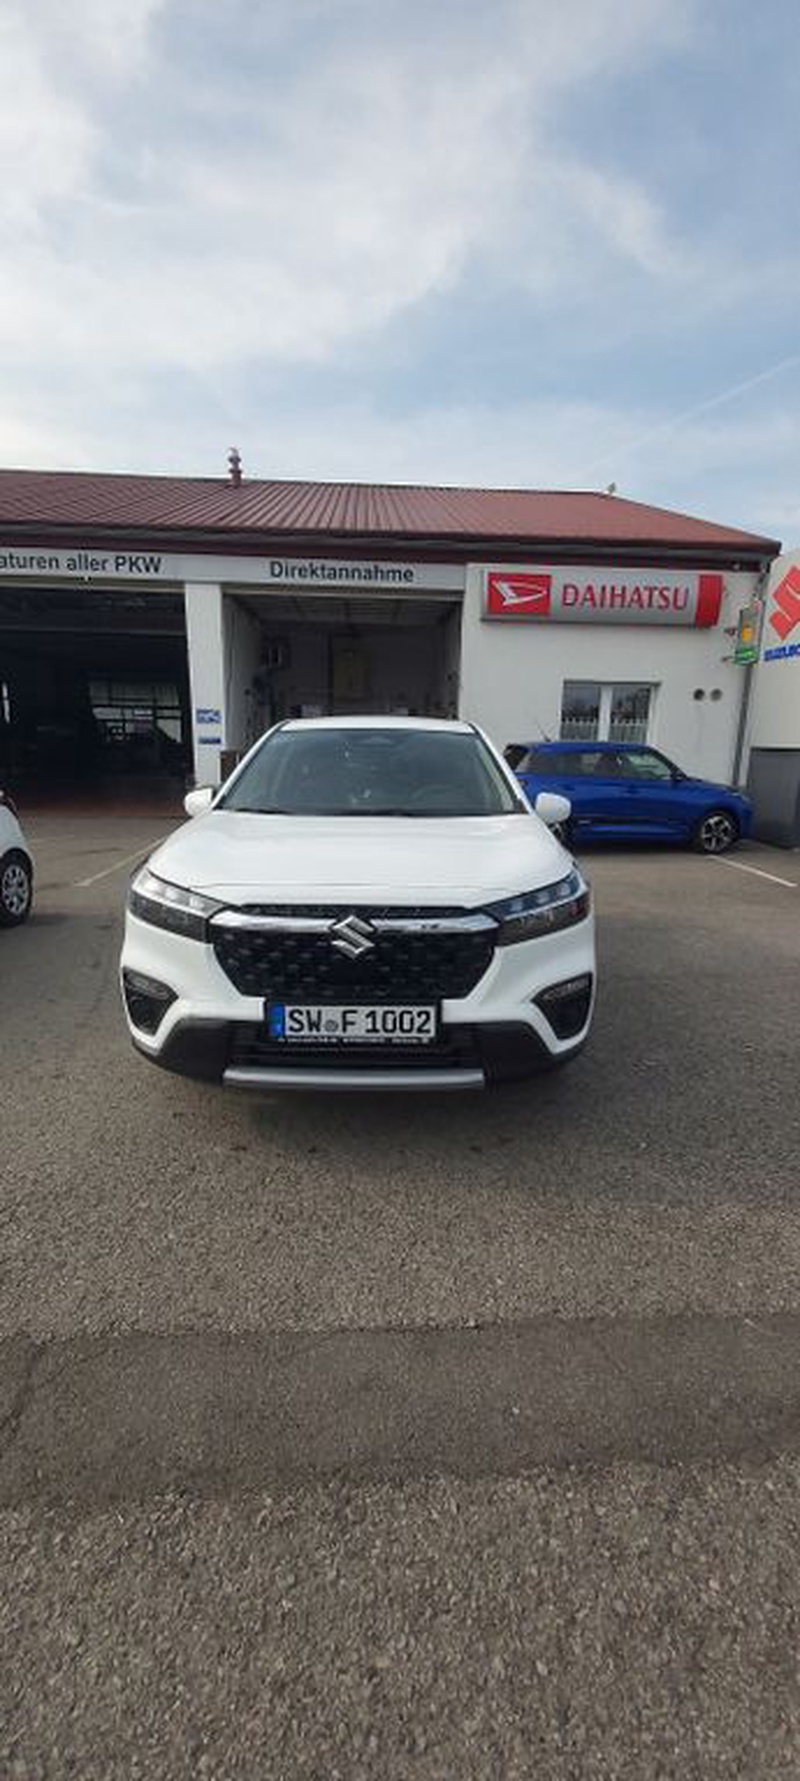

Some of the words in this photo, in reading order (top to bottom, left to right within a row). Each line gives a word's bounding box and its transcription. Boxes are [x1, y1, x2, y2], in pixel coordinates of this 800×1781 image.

[0, 552, 59, 569] aturen
[66, 553, 107, 571] aller
[114, 555, 162, 573] PKW
[269, 561, 414, 582] Direktannahme
[562, 584, 689, 611] DAIHATSU
[287, 1009, 322, 1033] SW
[341, 1010, 358, 1033] F
[365, 1010, 431, 1034] 1002
